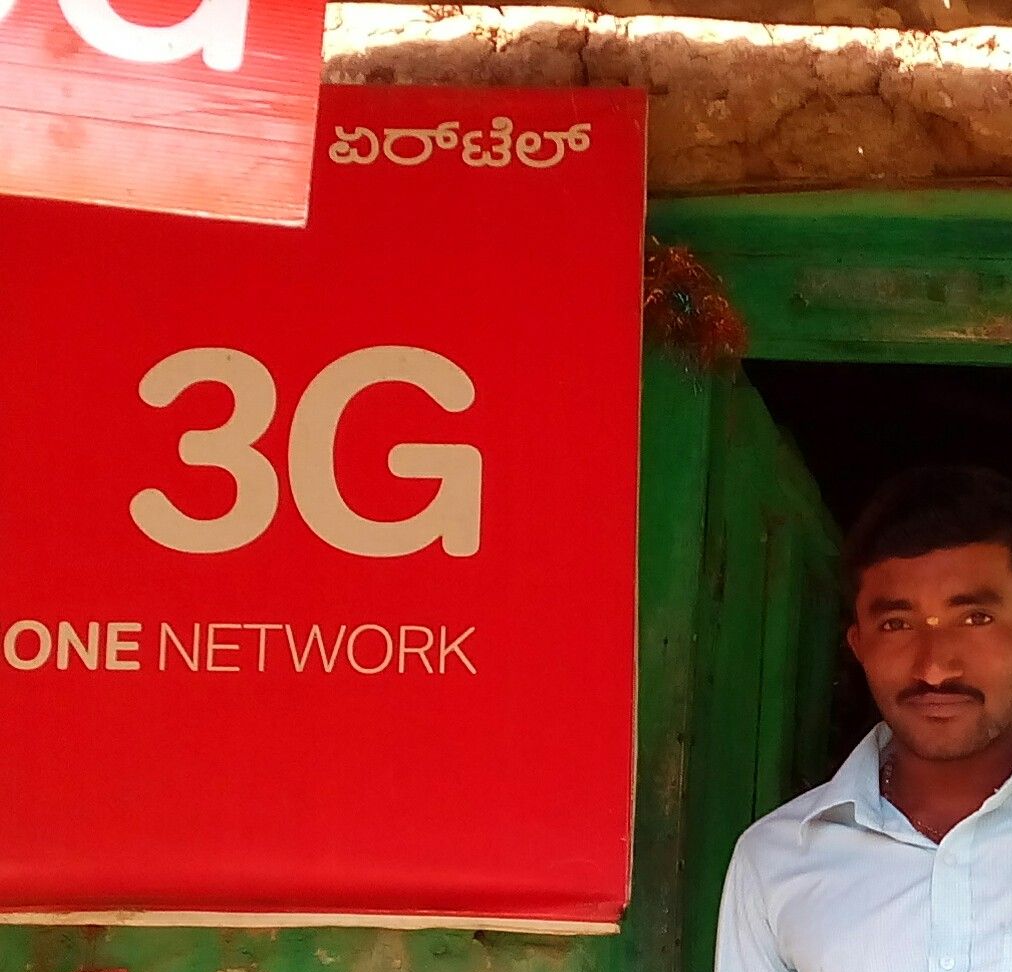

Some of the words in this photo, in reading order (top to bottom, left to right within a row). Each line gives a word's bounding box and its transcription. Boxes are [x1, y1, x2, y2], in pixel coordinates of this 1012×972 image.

[129, 345, 483, 557] 3G
[3, 619, 142, 671] ONE
[158, 622, 478, 675] NETWORK
